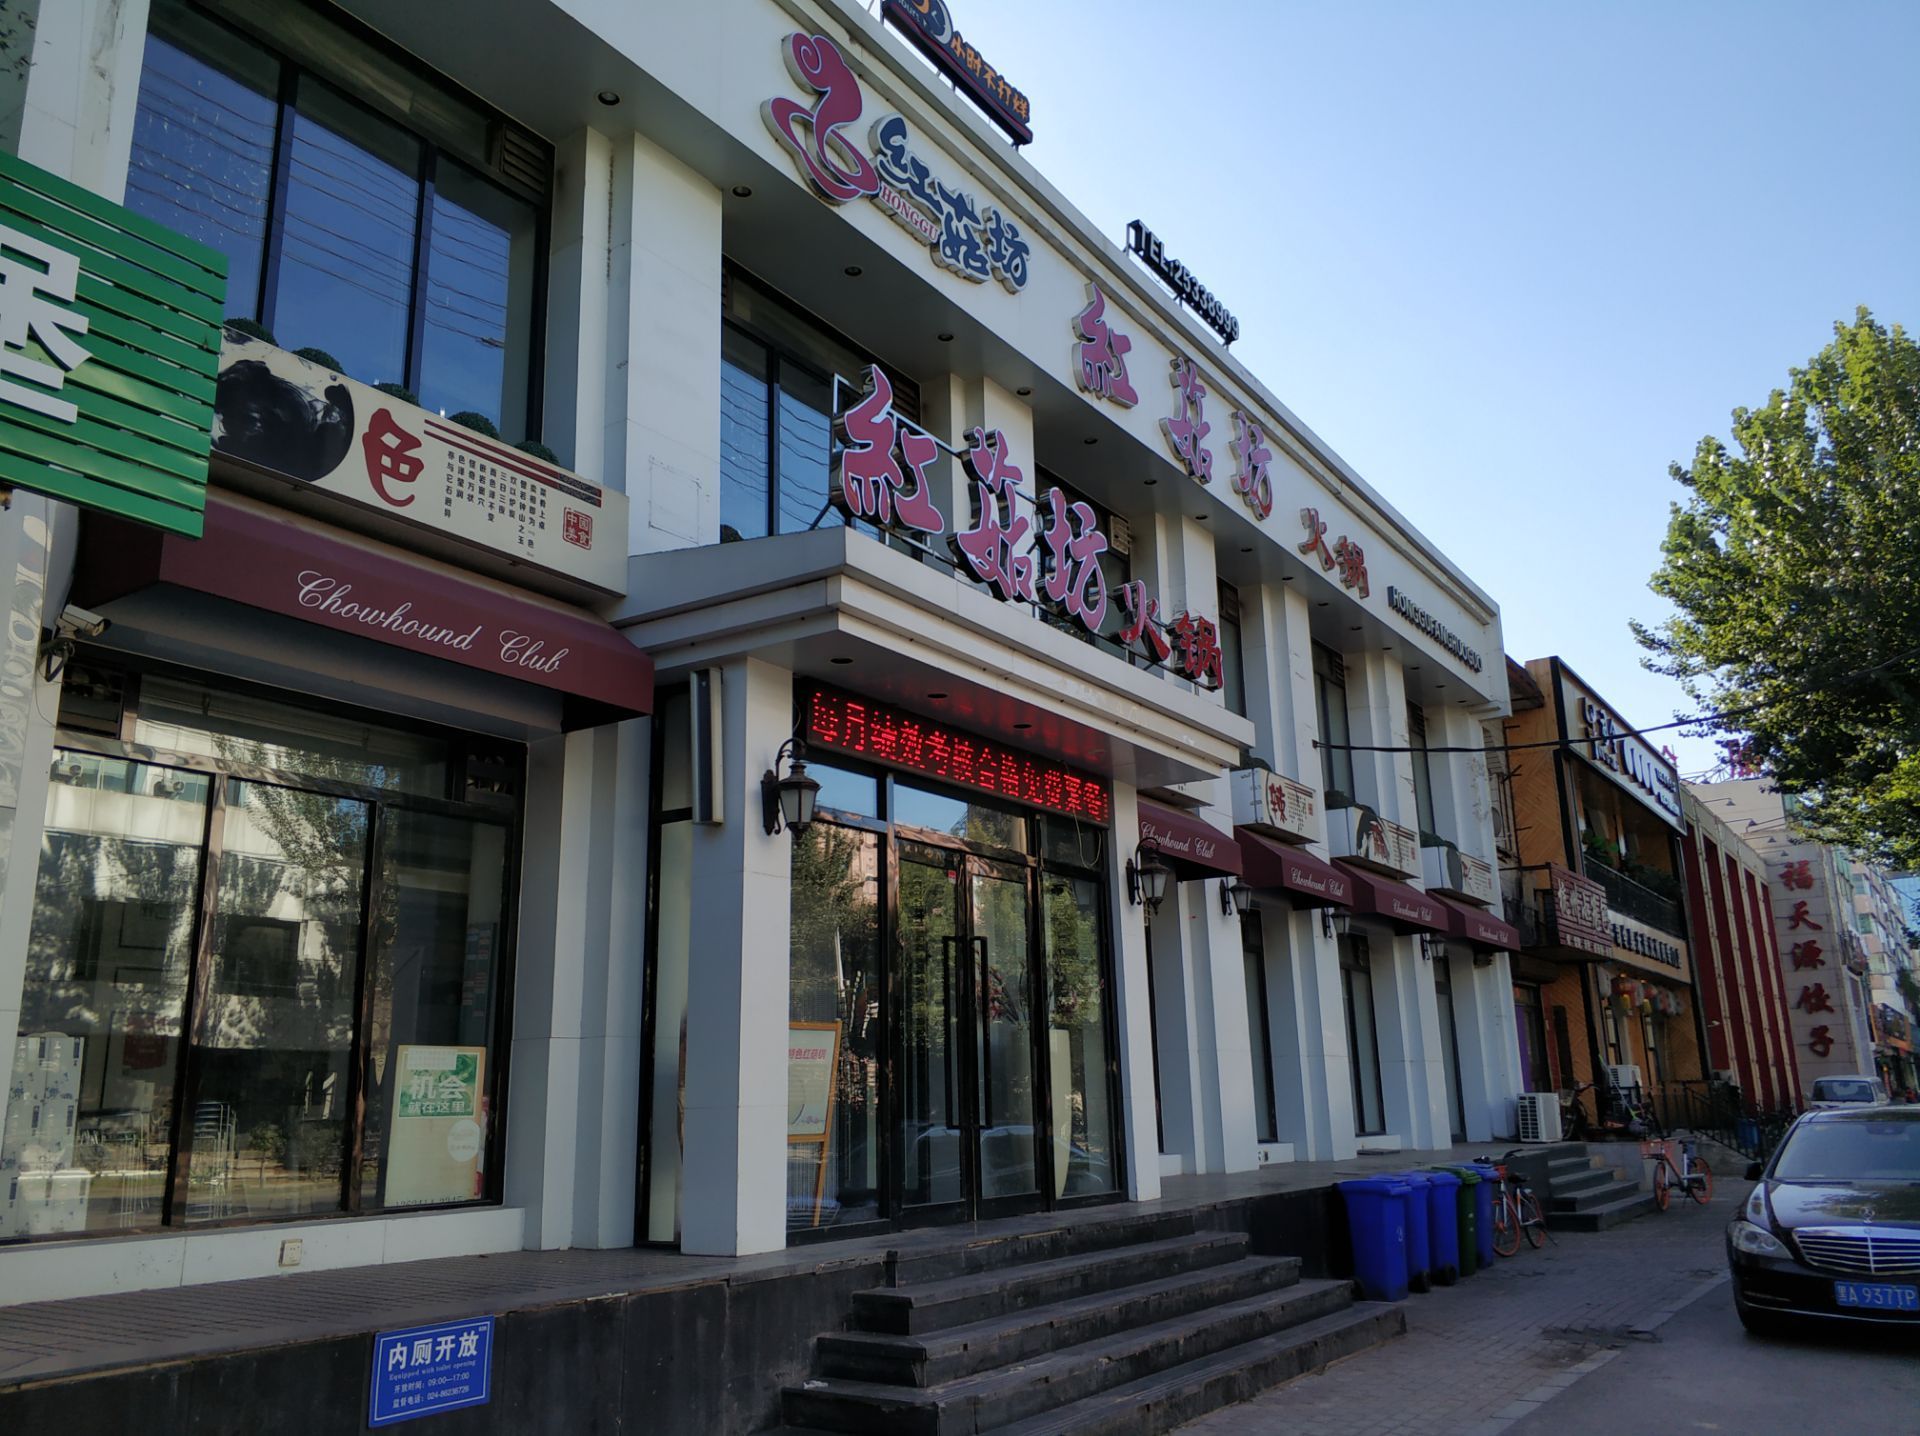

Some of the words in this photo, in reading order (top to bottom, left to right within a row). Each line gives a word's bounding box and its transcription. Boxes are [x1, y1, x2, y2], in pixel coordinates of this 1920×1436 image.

[880, 182, 940, 244] HONGGU
[362, 407, 425, 507] 色
[297, 570, 483, 651] Chowhound
[499, 629, 569, 674] Club
[1194, 836, 1217, 859] Club
[407, 1100, 466, 1114] 就在这里
[409, 1074, 469, 1100] 机会
[388, 1329, 480, 1372] 内厕开放
